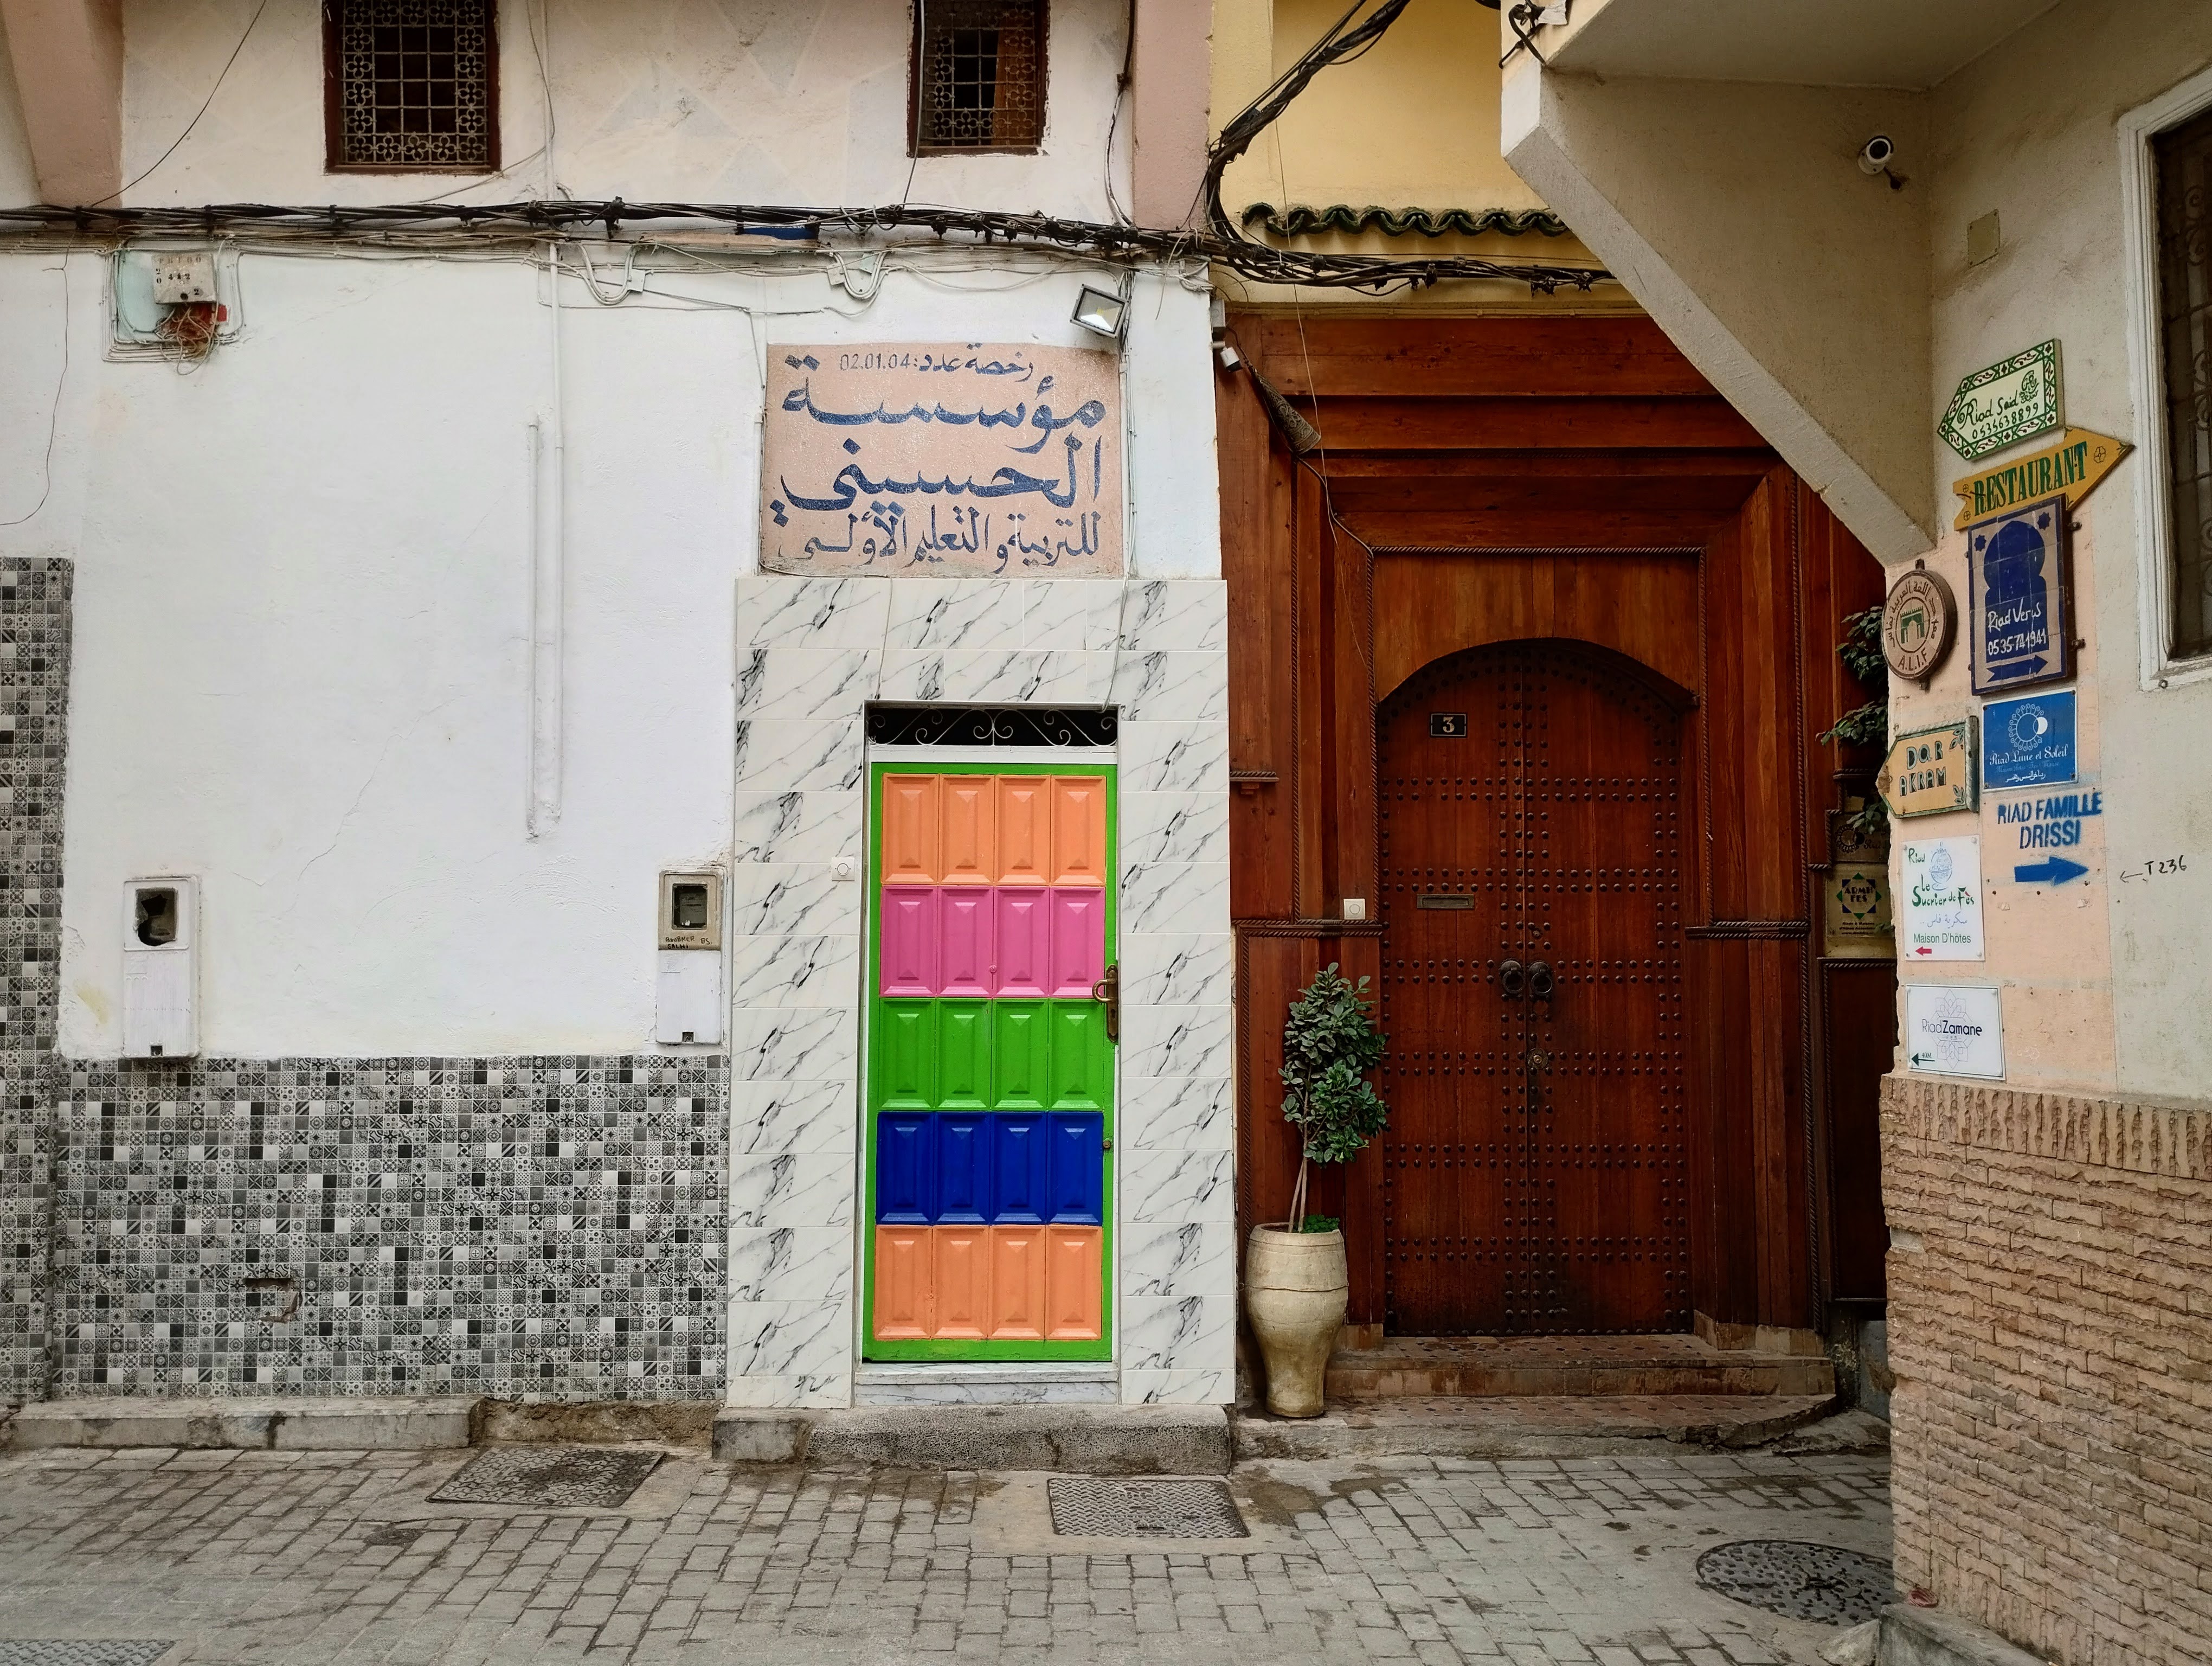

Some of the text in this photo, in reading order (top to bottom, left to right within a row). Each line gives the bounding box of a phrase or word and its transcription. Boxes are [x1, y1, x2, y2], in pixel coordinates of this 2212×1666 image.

[840, 353, 911, 371] 02.01.04
[964, 343, 1033, 382] رخصة
[782, 354, 1106, 454] مؤسسة
[1957, 389, 2018, 430] Riad Said
[1972, 402, 2039, 439] 0535638899
[770, 431, 1102, 527] الحسيني
[1973, 441, 2087, 516] RESTAURANT
[1007, 511, 1102, 567] للتربية
[1889, 580, 1912, 614] العربية
[1988, 608, 2011, 633] Riad
[1442, 716, 1455, 733] 3
[1989, 744, 2068, 765] Riad Lune et Soleil
[1900, 766, 1946, 797] AKRAM
[1998, 792, 2102, 824] RIAD FAMILLE
[2020, 819, 2081, 849] DRISSI
[1908, 848, 1925, 866] Riad
[1912, 886, 1975, 909] Sucrier de Fès
[1914, 932, 1971, 944] Maison D'hôtes
